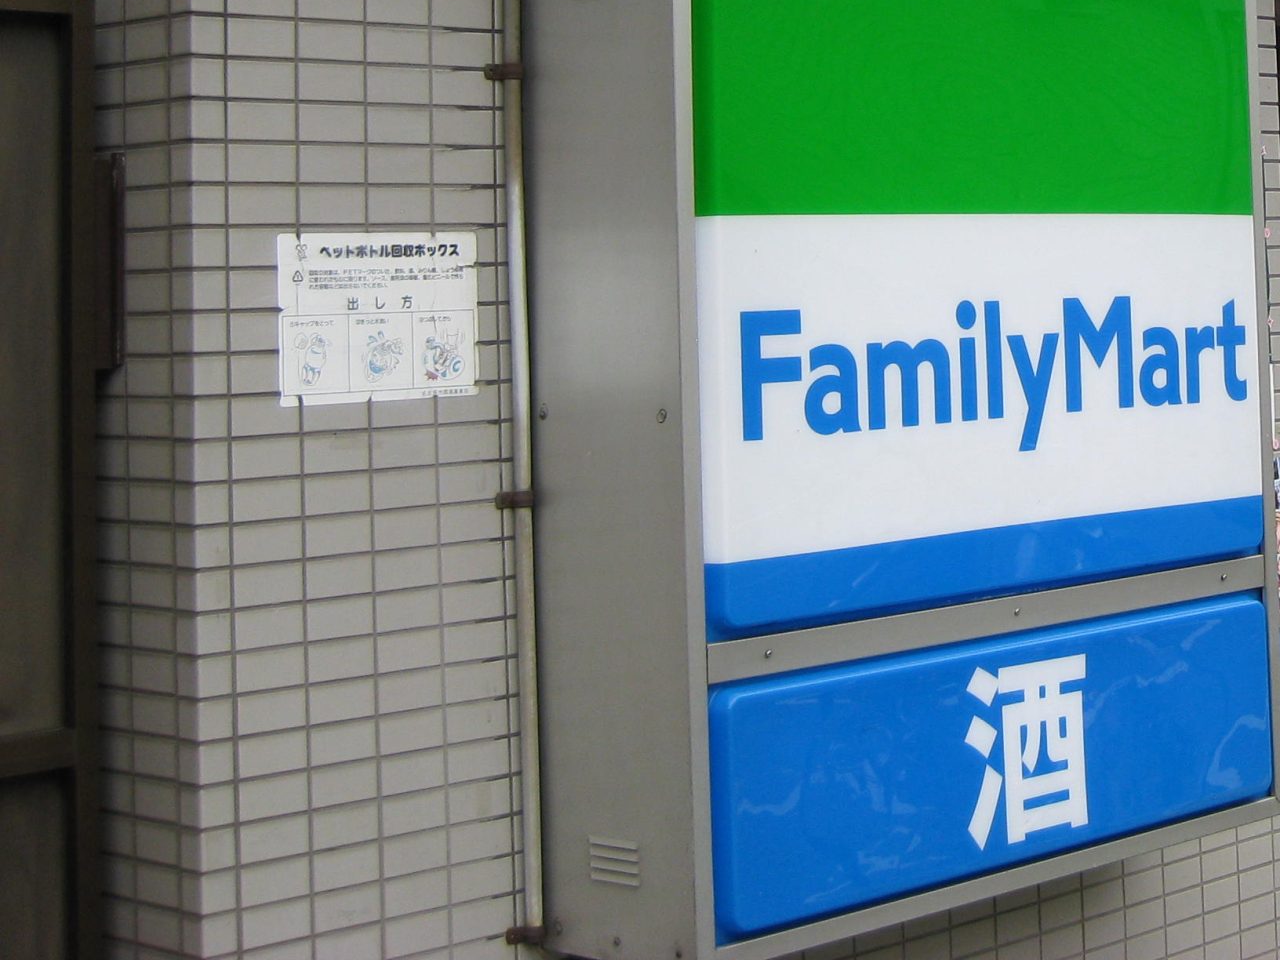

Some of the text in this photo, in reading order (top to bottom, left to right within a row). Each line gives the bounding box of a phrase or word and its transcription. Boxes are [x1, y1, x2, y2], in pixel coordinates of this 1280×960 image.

[319, 243, 461, 259] ペットボトル回収ボックス
[739, 295, 1248, 452] FamilyMart
[963, 653, 1089, 851] 酒
